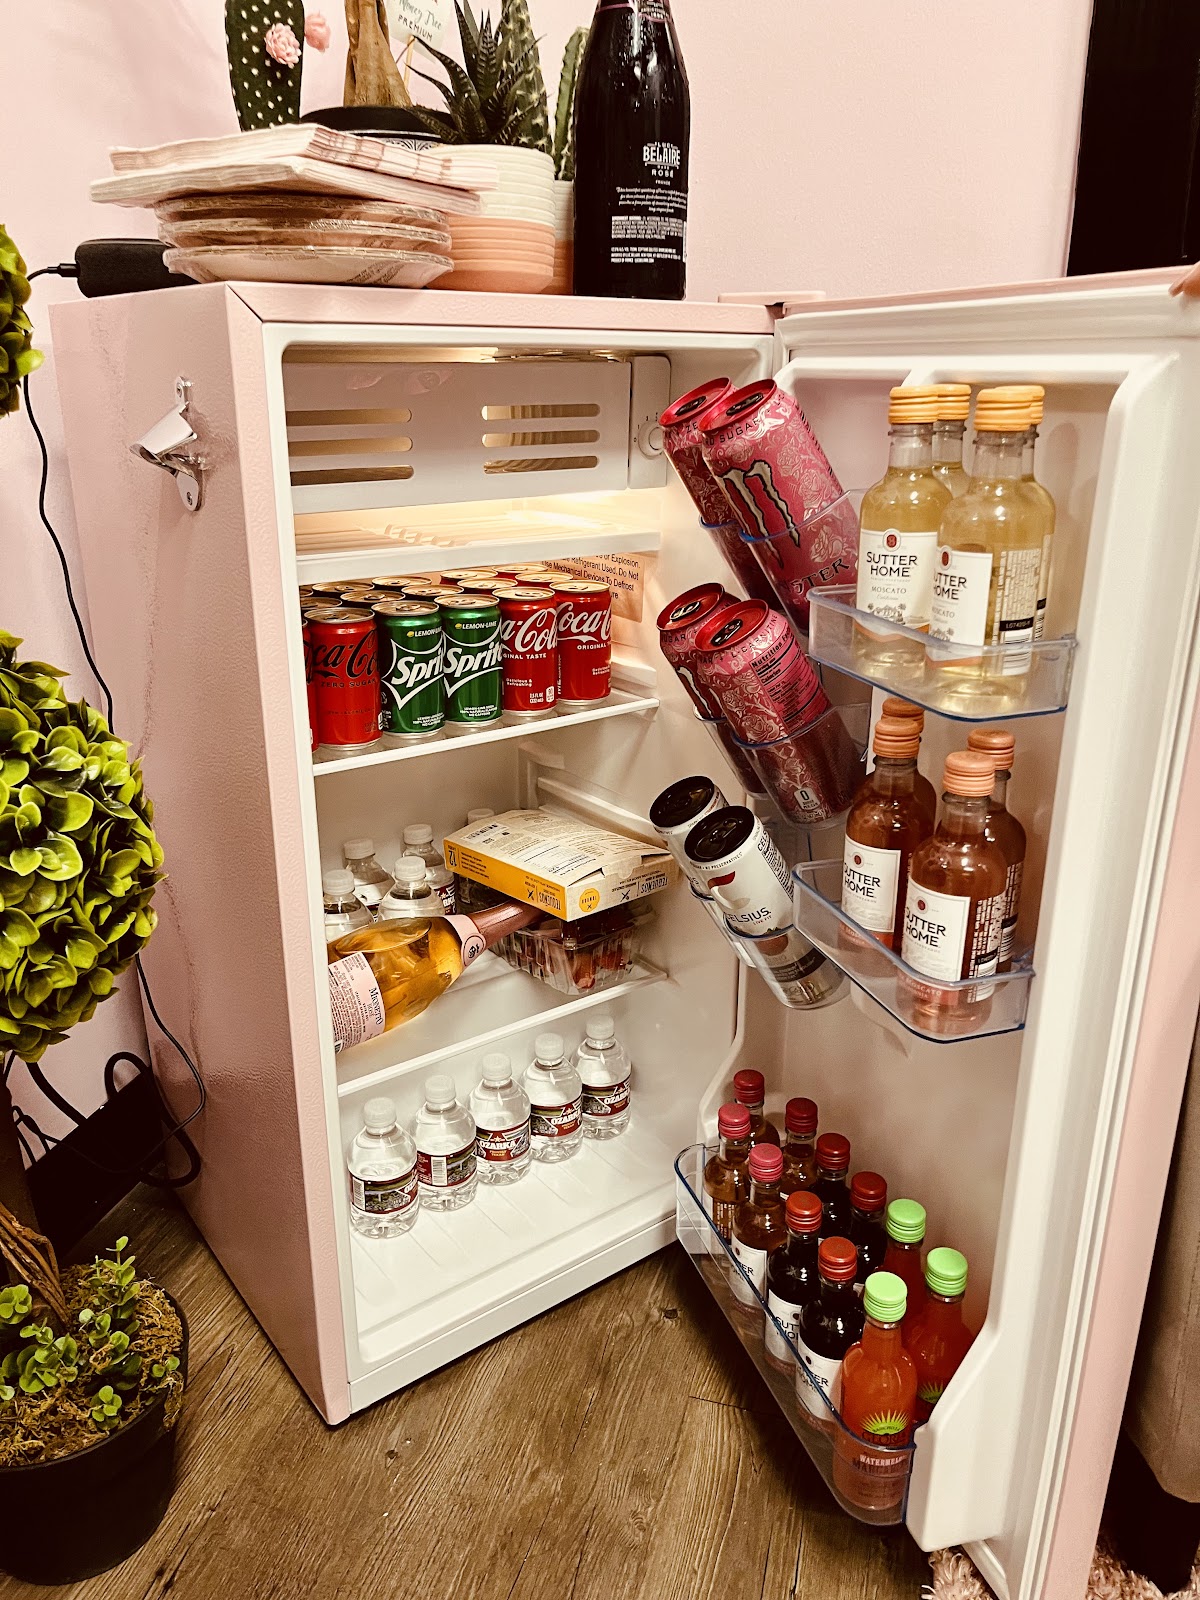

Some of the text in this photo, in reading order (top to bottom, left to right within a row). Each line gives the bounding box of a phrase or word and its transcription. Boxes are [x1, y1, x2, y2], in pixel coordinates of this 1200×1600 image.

[397, 14, 433, 42] PREMIUM
[642, 145, 680, 166] BELAIRE
[866, 551, 918, 566] SUTTER
[553, 562, 583, 578] Mechanical
[628, 570, 639, 581] Not
[870, 565, 911, 578] HOME
[871, 586, 907, 595] MOSCATO
[576, 642, 607, 650] ORIGINAL
[443, 641, 503, 678] Sprit
[799, 790, 810, 801] 0
[844, 877, 875, 898] HOME
[905, 921, 939, 948] HOME
[479, 1140, 517, 1150] OZARKA
[859, 1454, 908, 1466] WATERMEL
